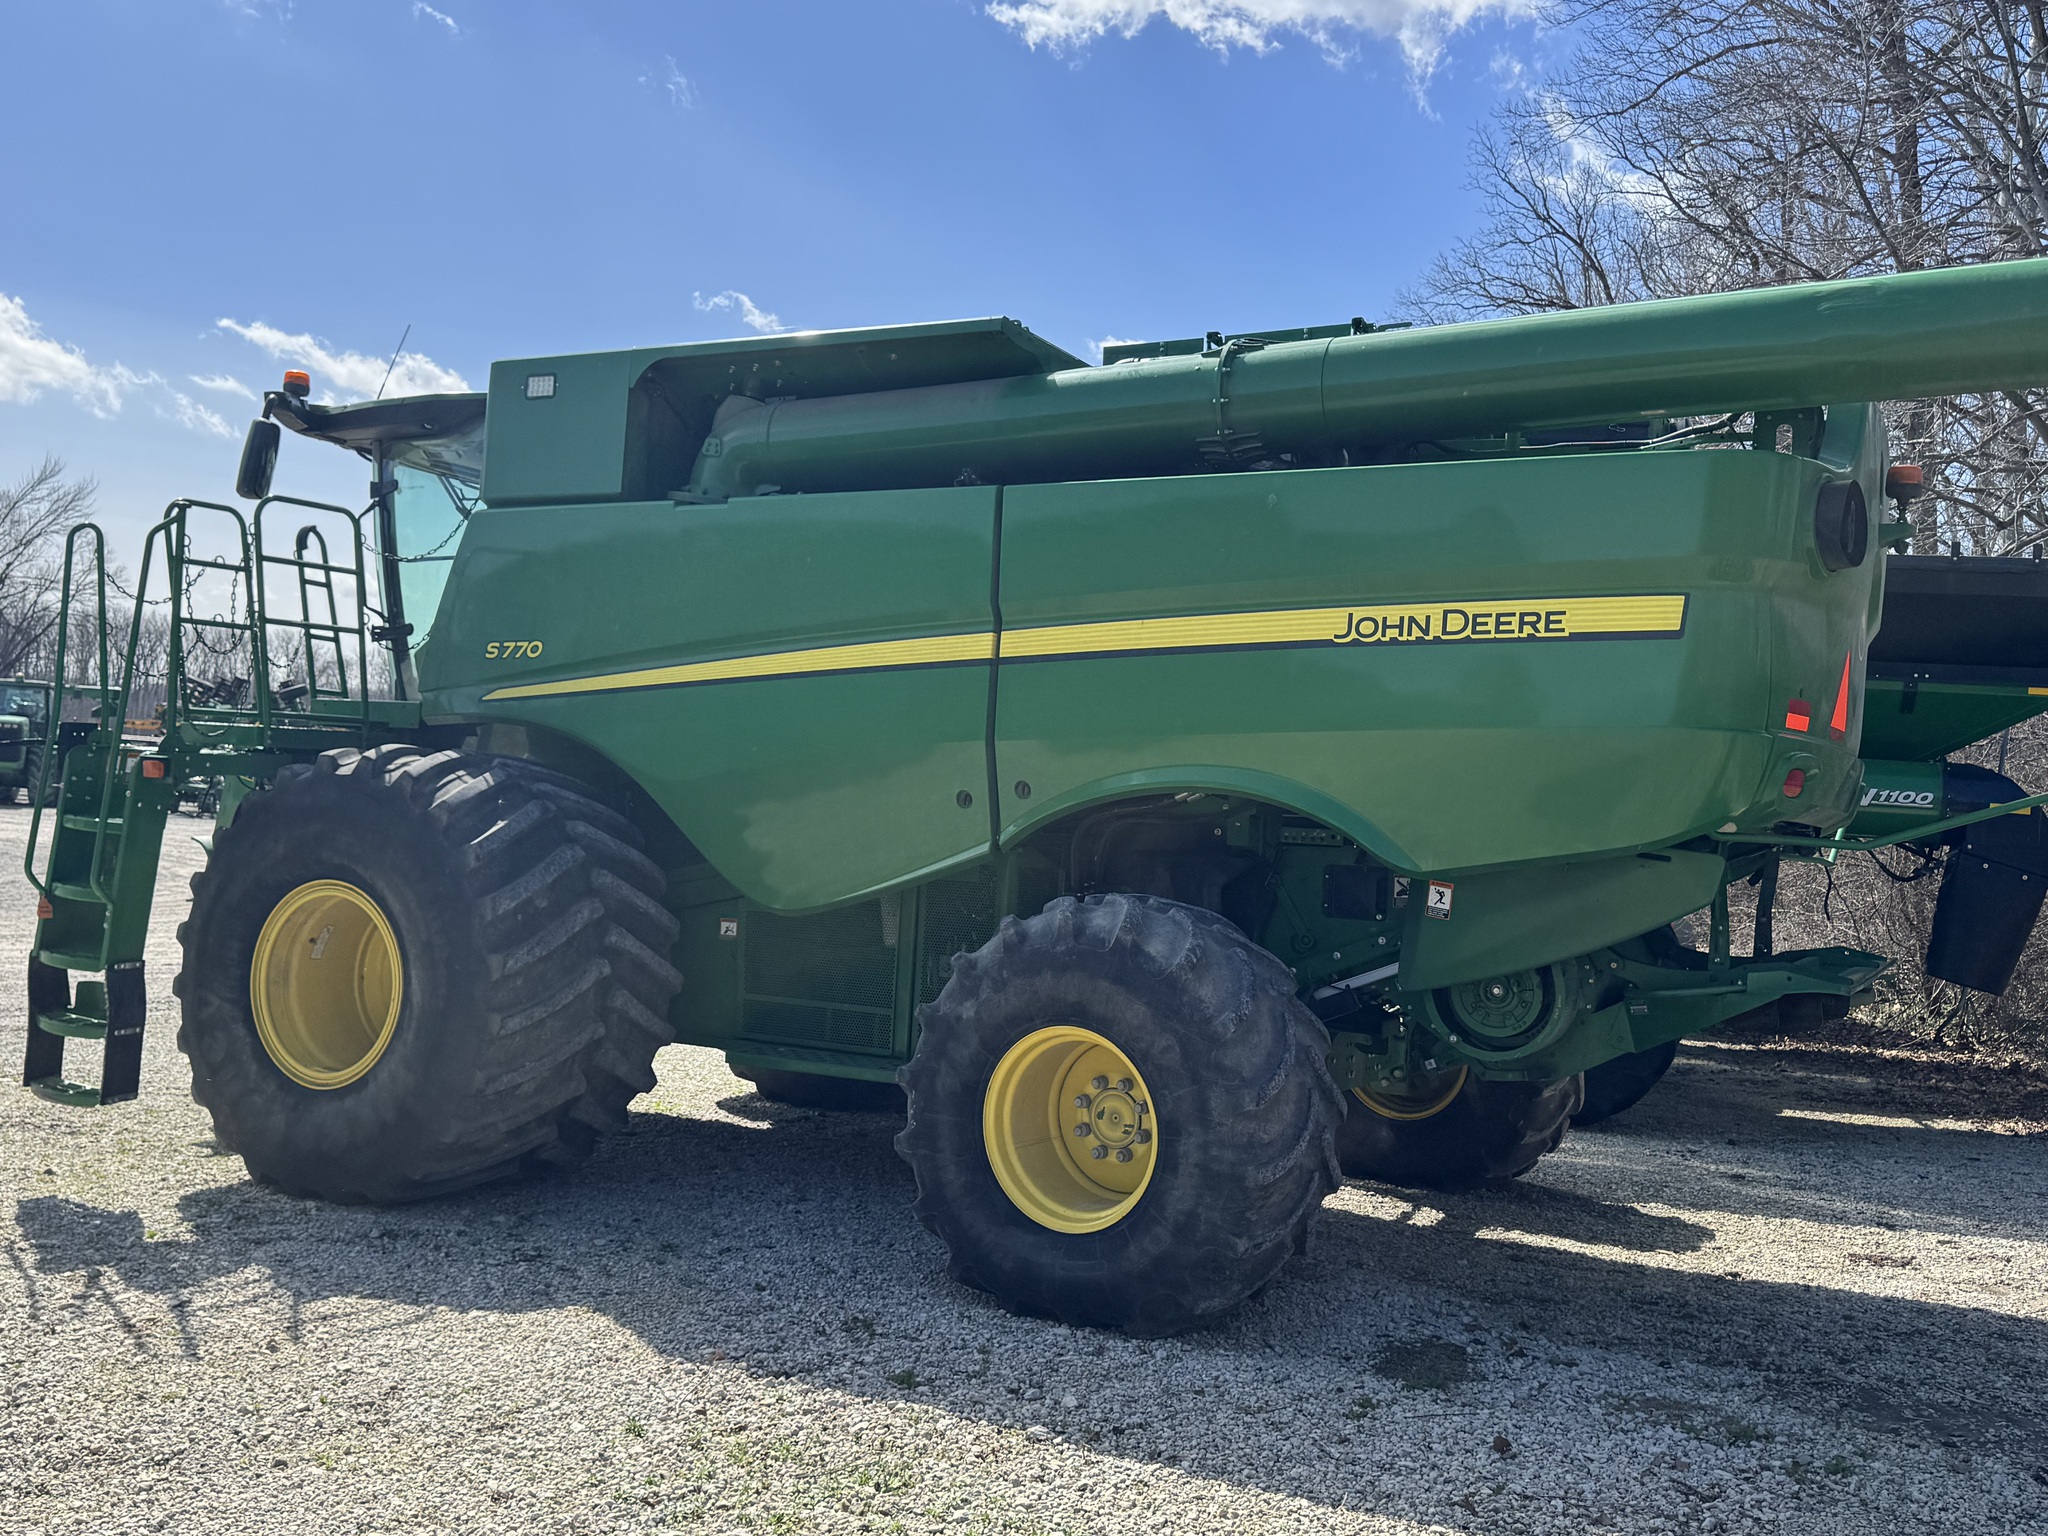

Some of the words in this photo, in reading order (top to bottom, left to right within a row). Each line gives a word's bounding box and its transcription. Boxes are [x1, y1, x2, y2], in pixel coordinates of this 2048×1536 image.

[1333, 612, 1432, 640] JOHN
[1441, 608, 1567, 637] DEERE
[485, 640, 543, 659] S770
